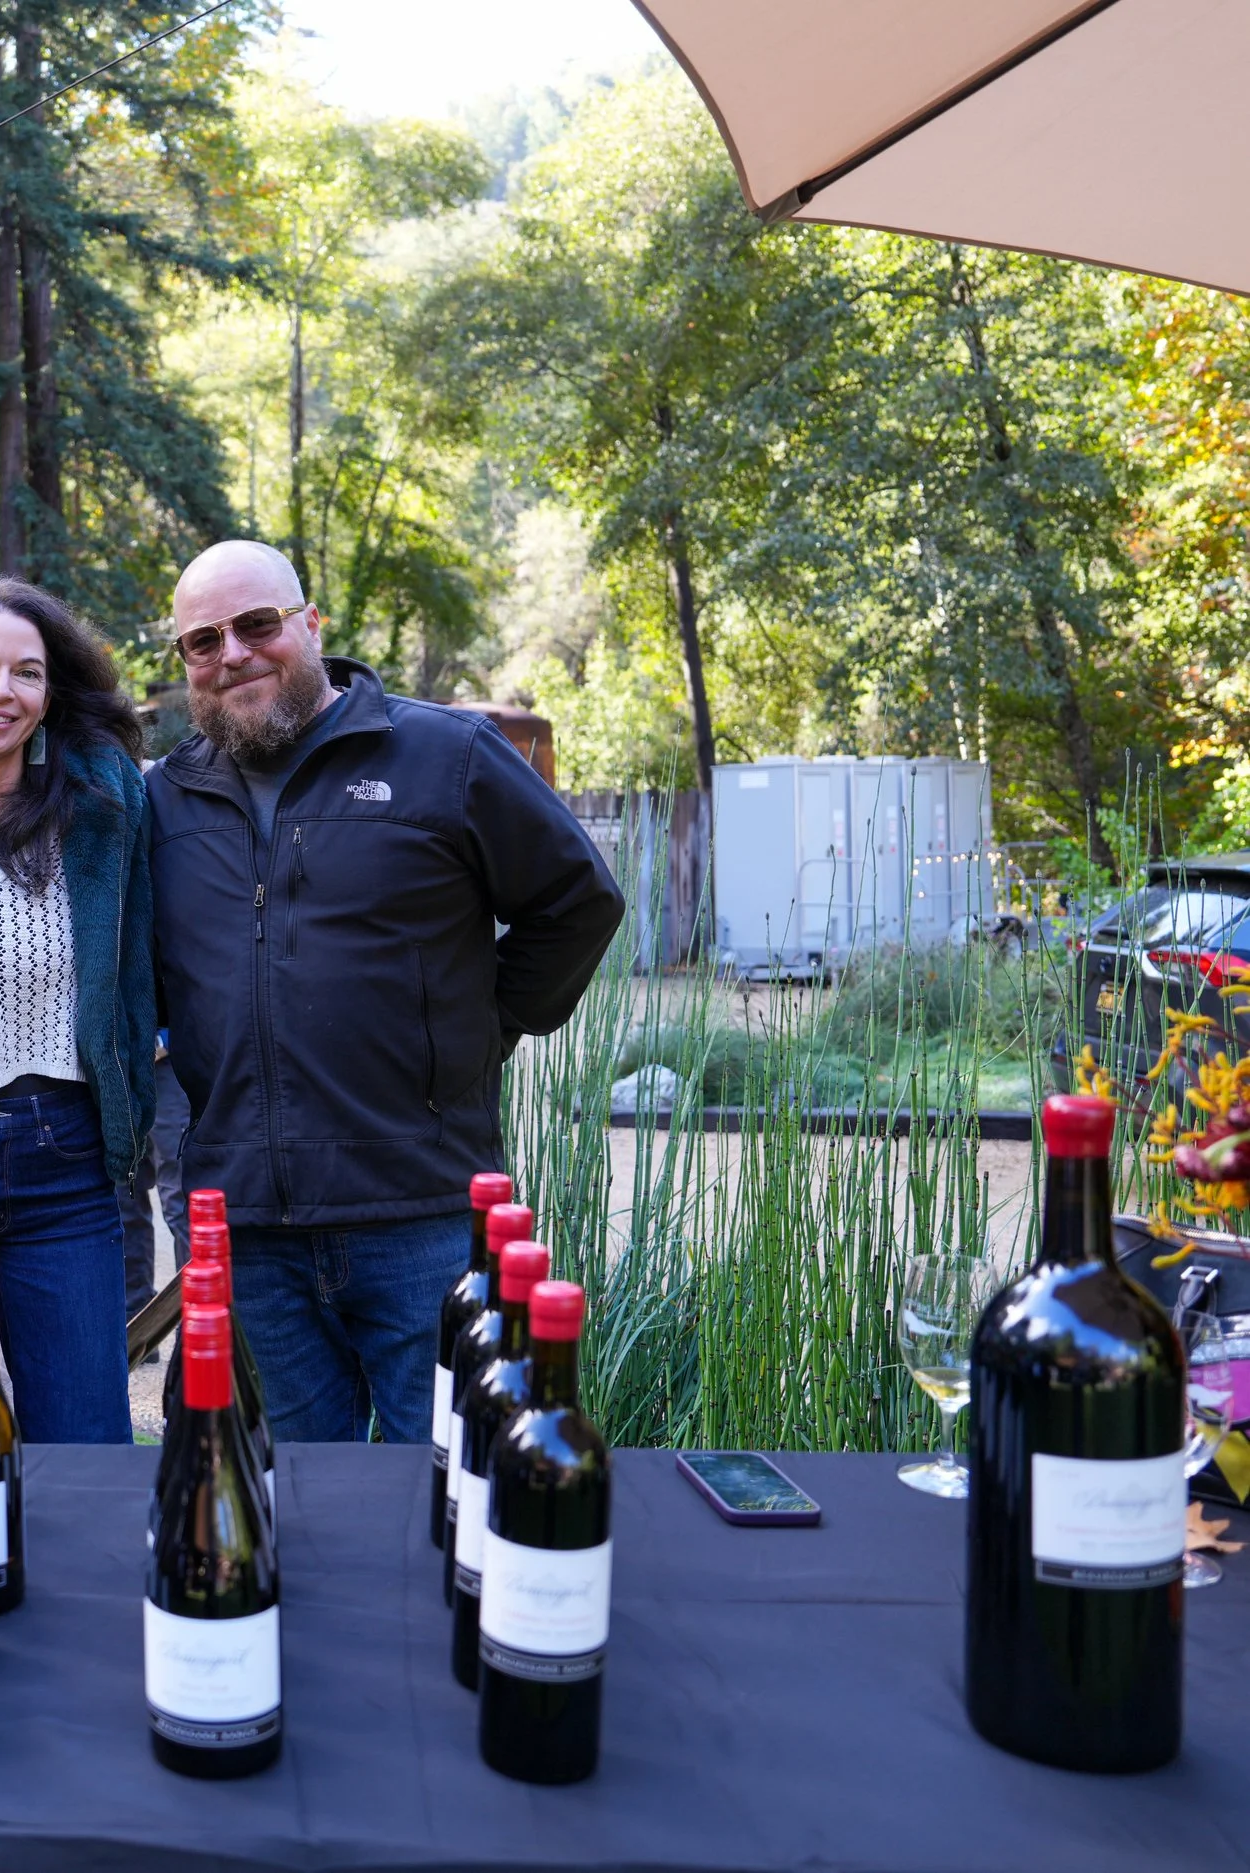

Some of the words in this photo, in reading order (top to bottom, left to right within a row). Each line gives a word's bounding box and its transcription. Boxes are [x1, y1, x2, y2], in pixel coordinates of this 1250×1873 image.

[361, 779, 378, 788] THE
[346, 785, 377, 794] NORTH
[353, 792, 377, 800] FACE
